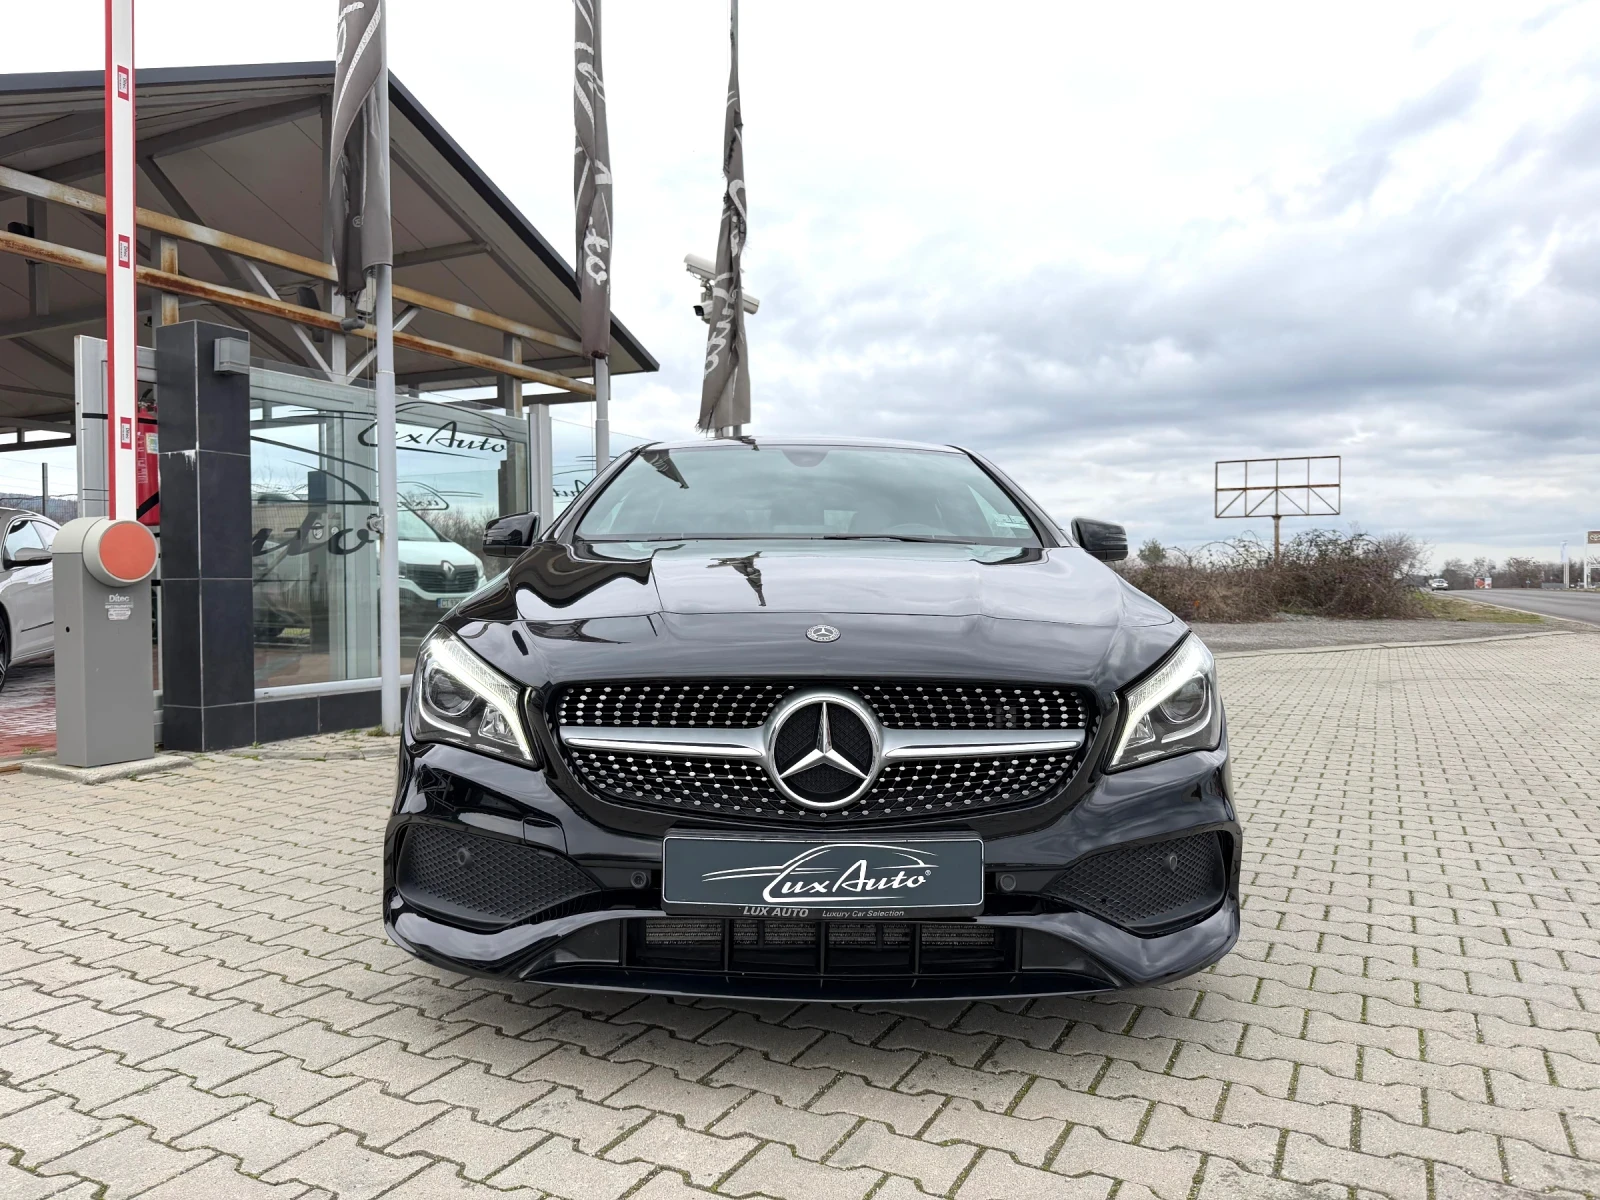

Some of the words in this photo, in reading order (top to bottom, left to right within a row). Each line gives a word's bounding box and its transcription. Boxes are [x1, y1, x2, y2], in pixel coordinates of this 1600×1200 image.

[743, 906, 770, 916] LUX
[771, 908, 809, 918] AUTO
[822, 910, 851, 918] Luxury
